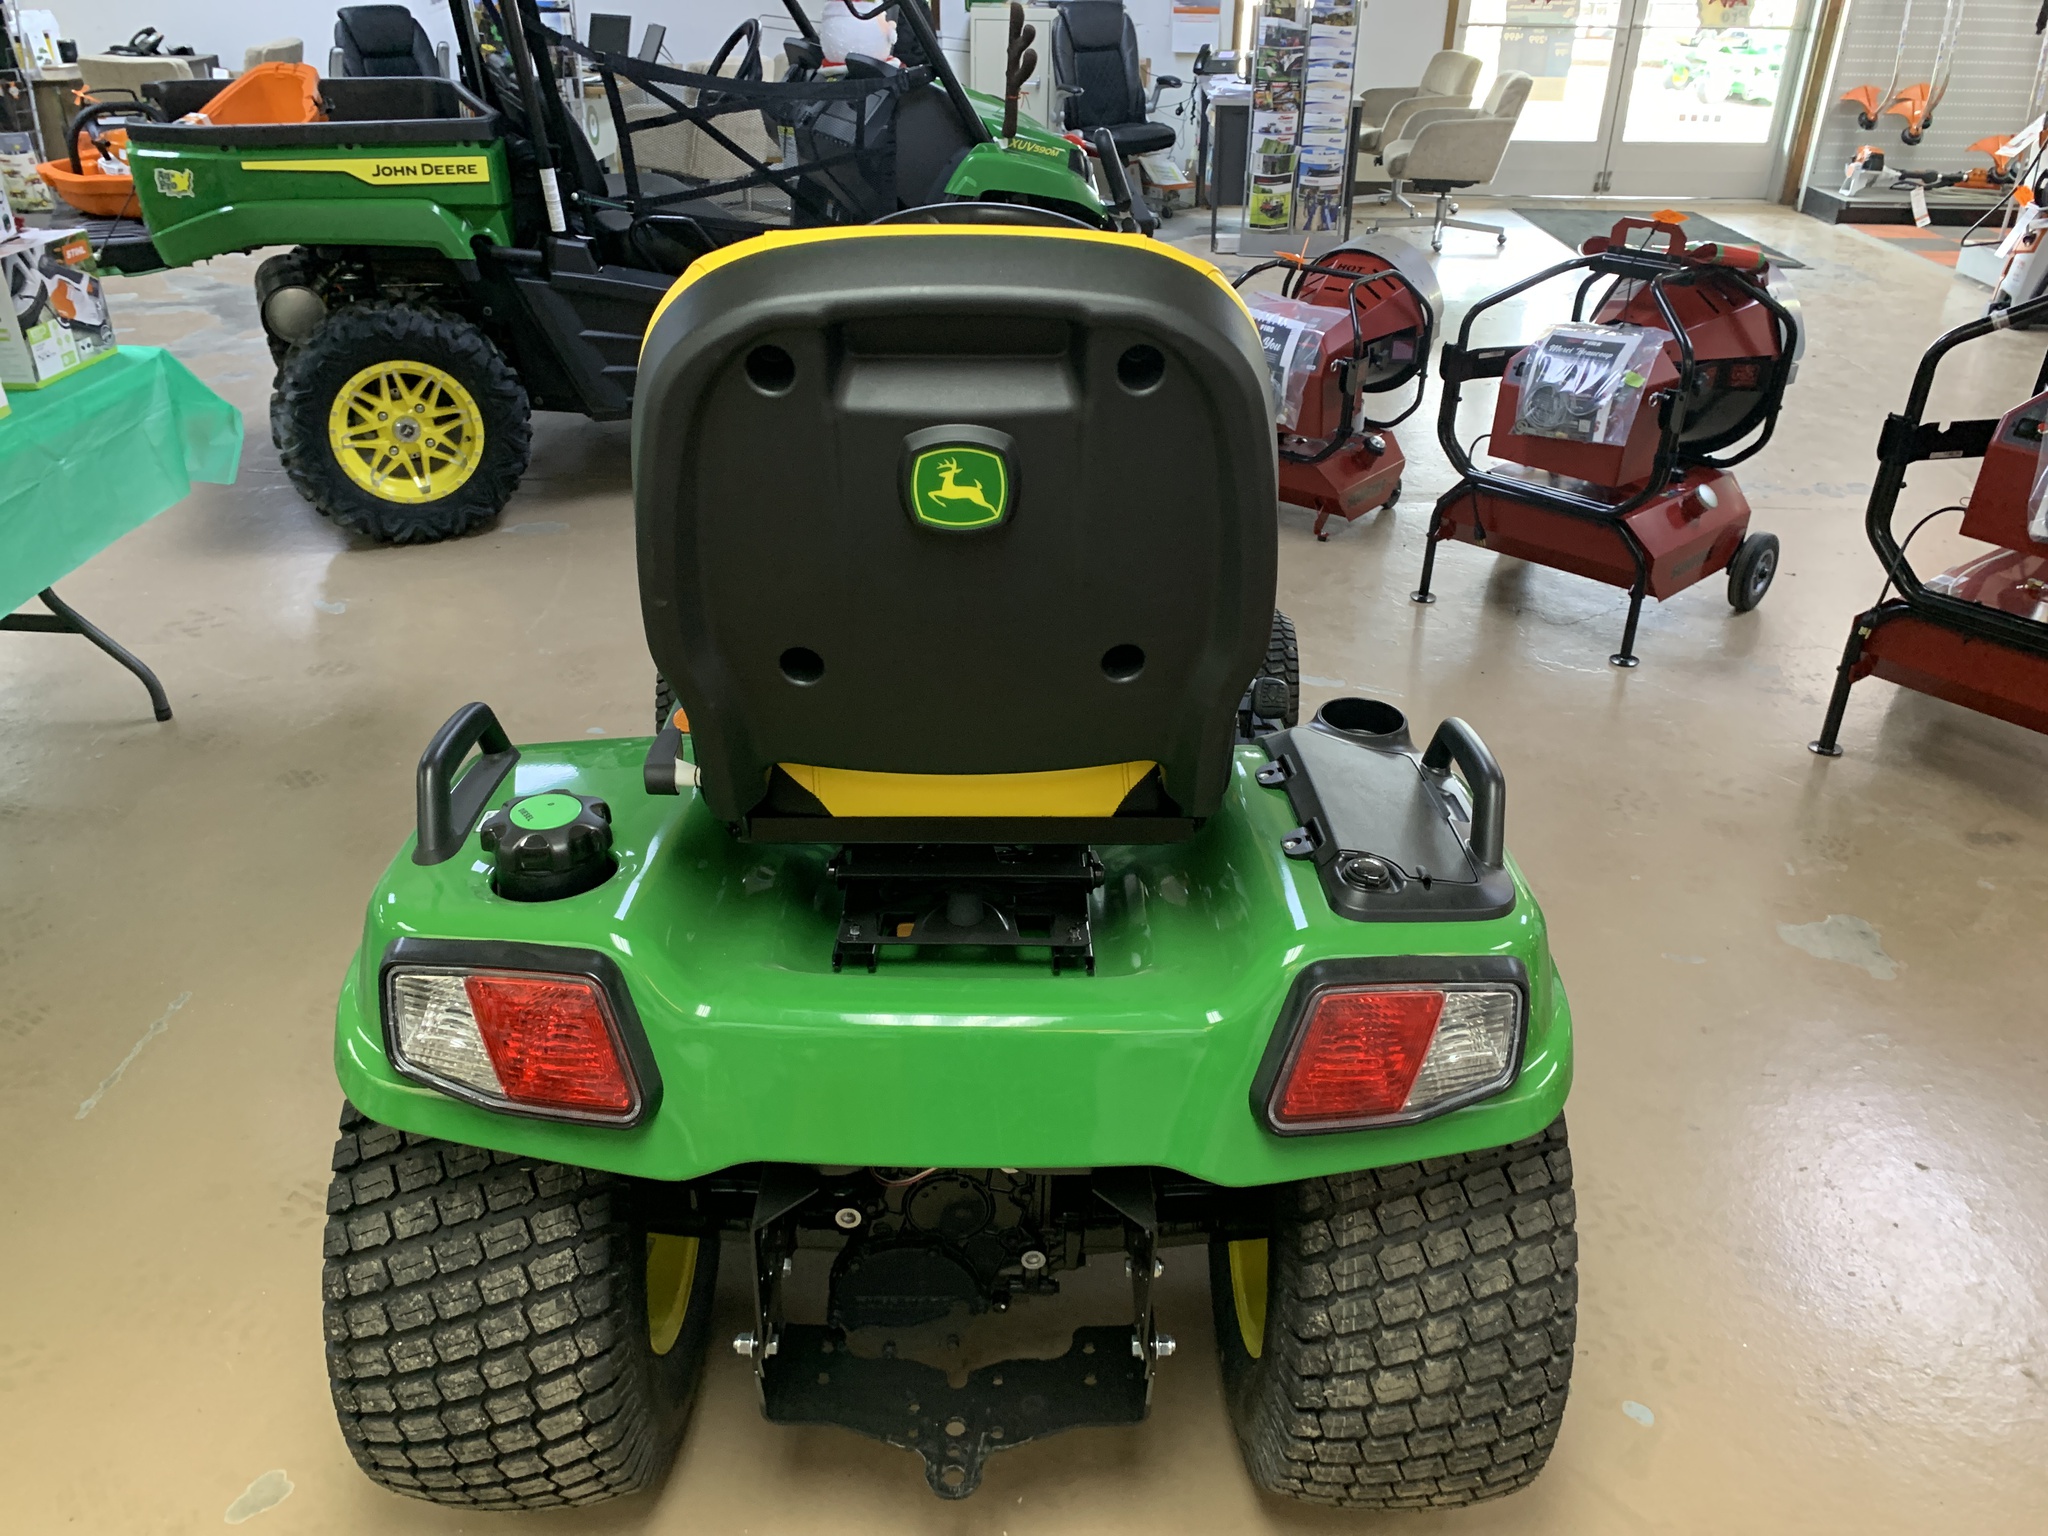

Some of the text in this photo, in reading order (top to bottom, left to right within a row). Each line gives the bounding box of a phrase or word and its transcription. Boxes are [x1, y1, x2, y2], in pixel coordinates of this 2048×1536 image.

[1009, 138, 1059, 156] XUV590M
[372, 163, 478, 177] JOHN DEERE
[66, 246, 86, 259] STIHL
[1337, 263, 1365, 273] HOT
[1262, 337, 1281, 351] You
[518, 807, 534, 822] DIESEL
